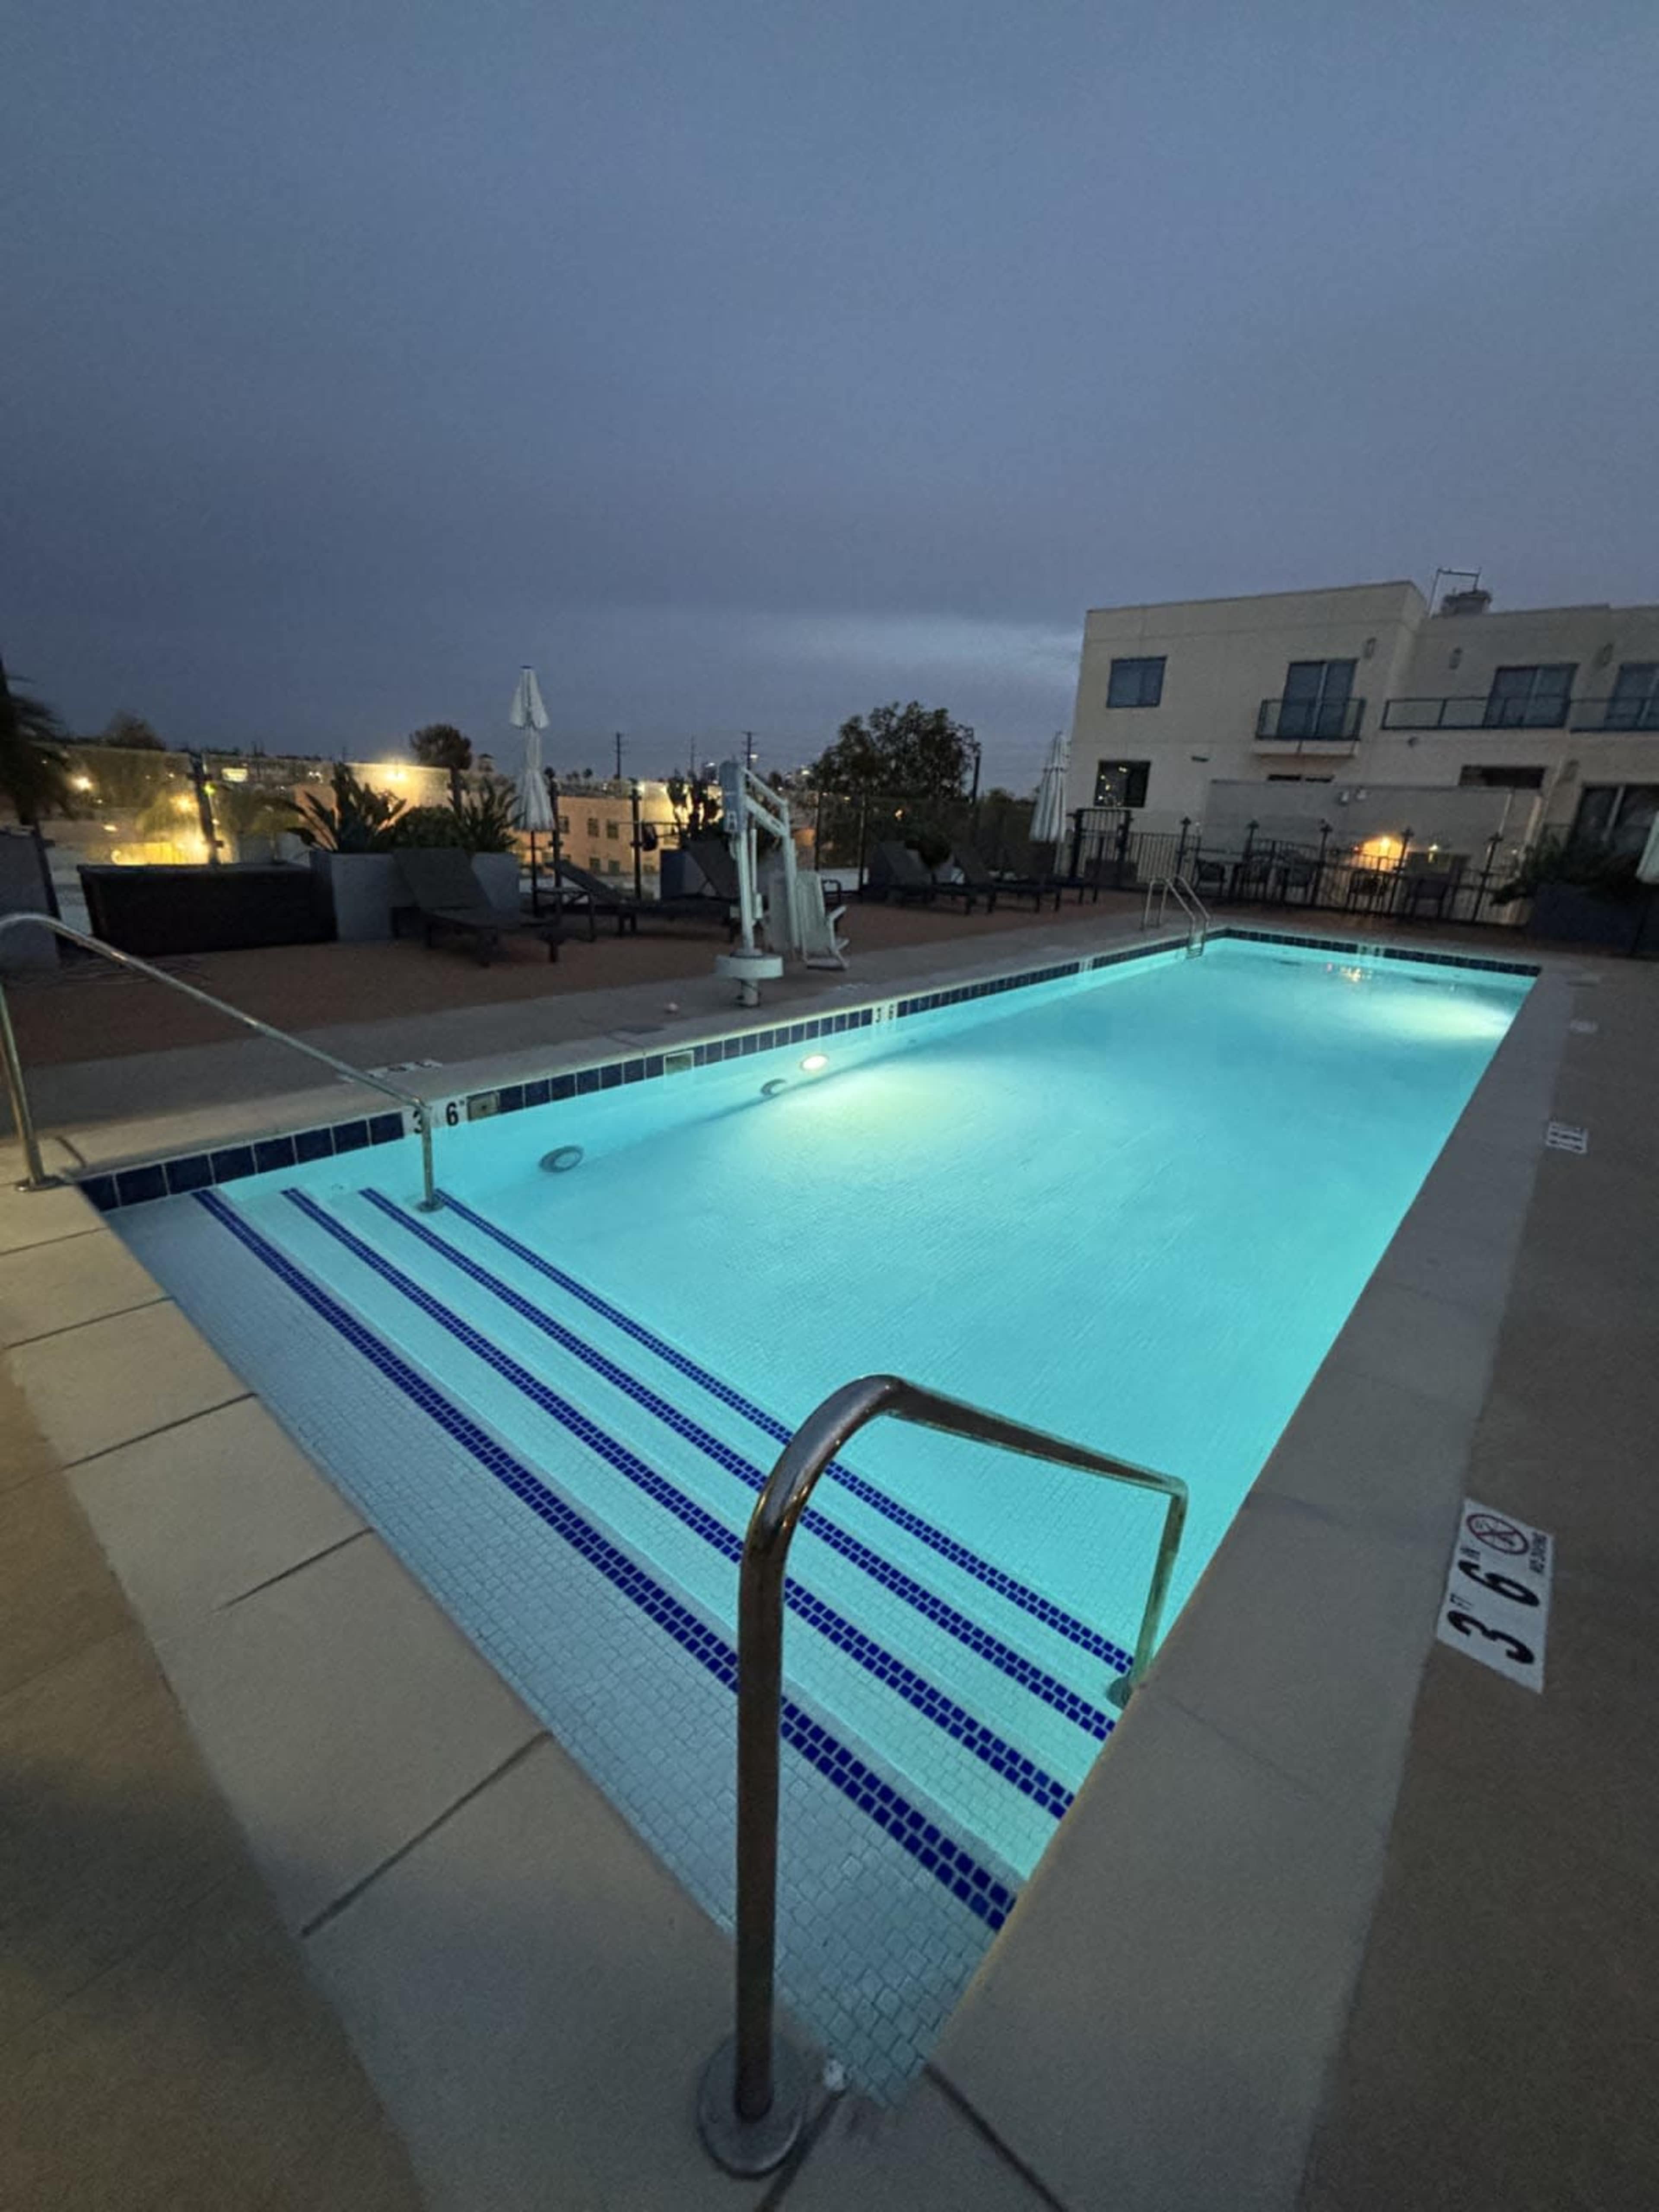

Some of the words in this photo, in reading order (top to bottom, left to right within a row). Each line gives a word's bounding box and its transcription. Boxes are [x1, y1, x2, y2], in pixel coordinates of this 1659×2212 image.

[446, 1102, 458, 1126] 6
[1459, 1560, 1539, 1606] 6
[1447, 1611, 1534, 1664] 3
